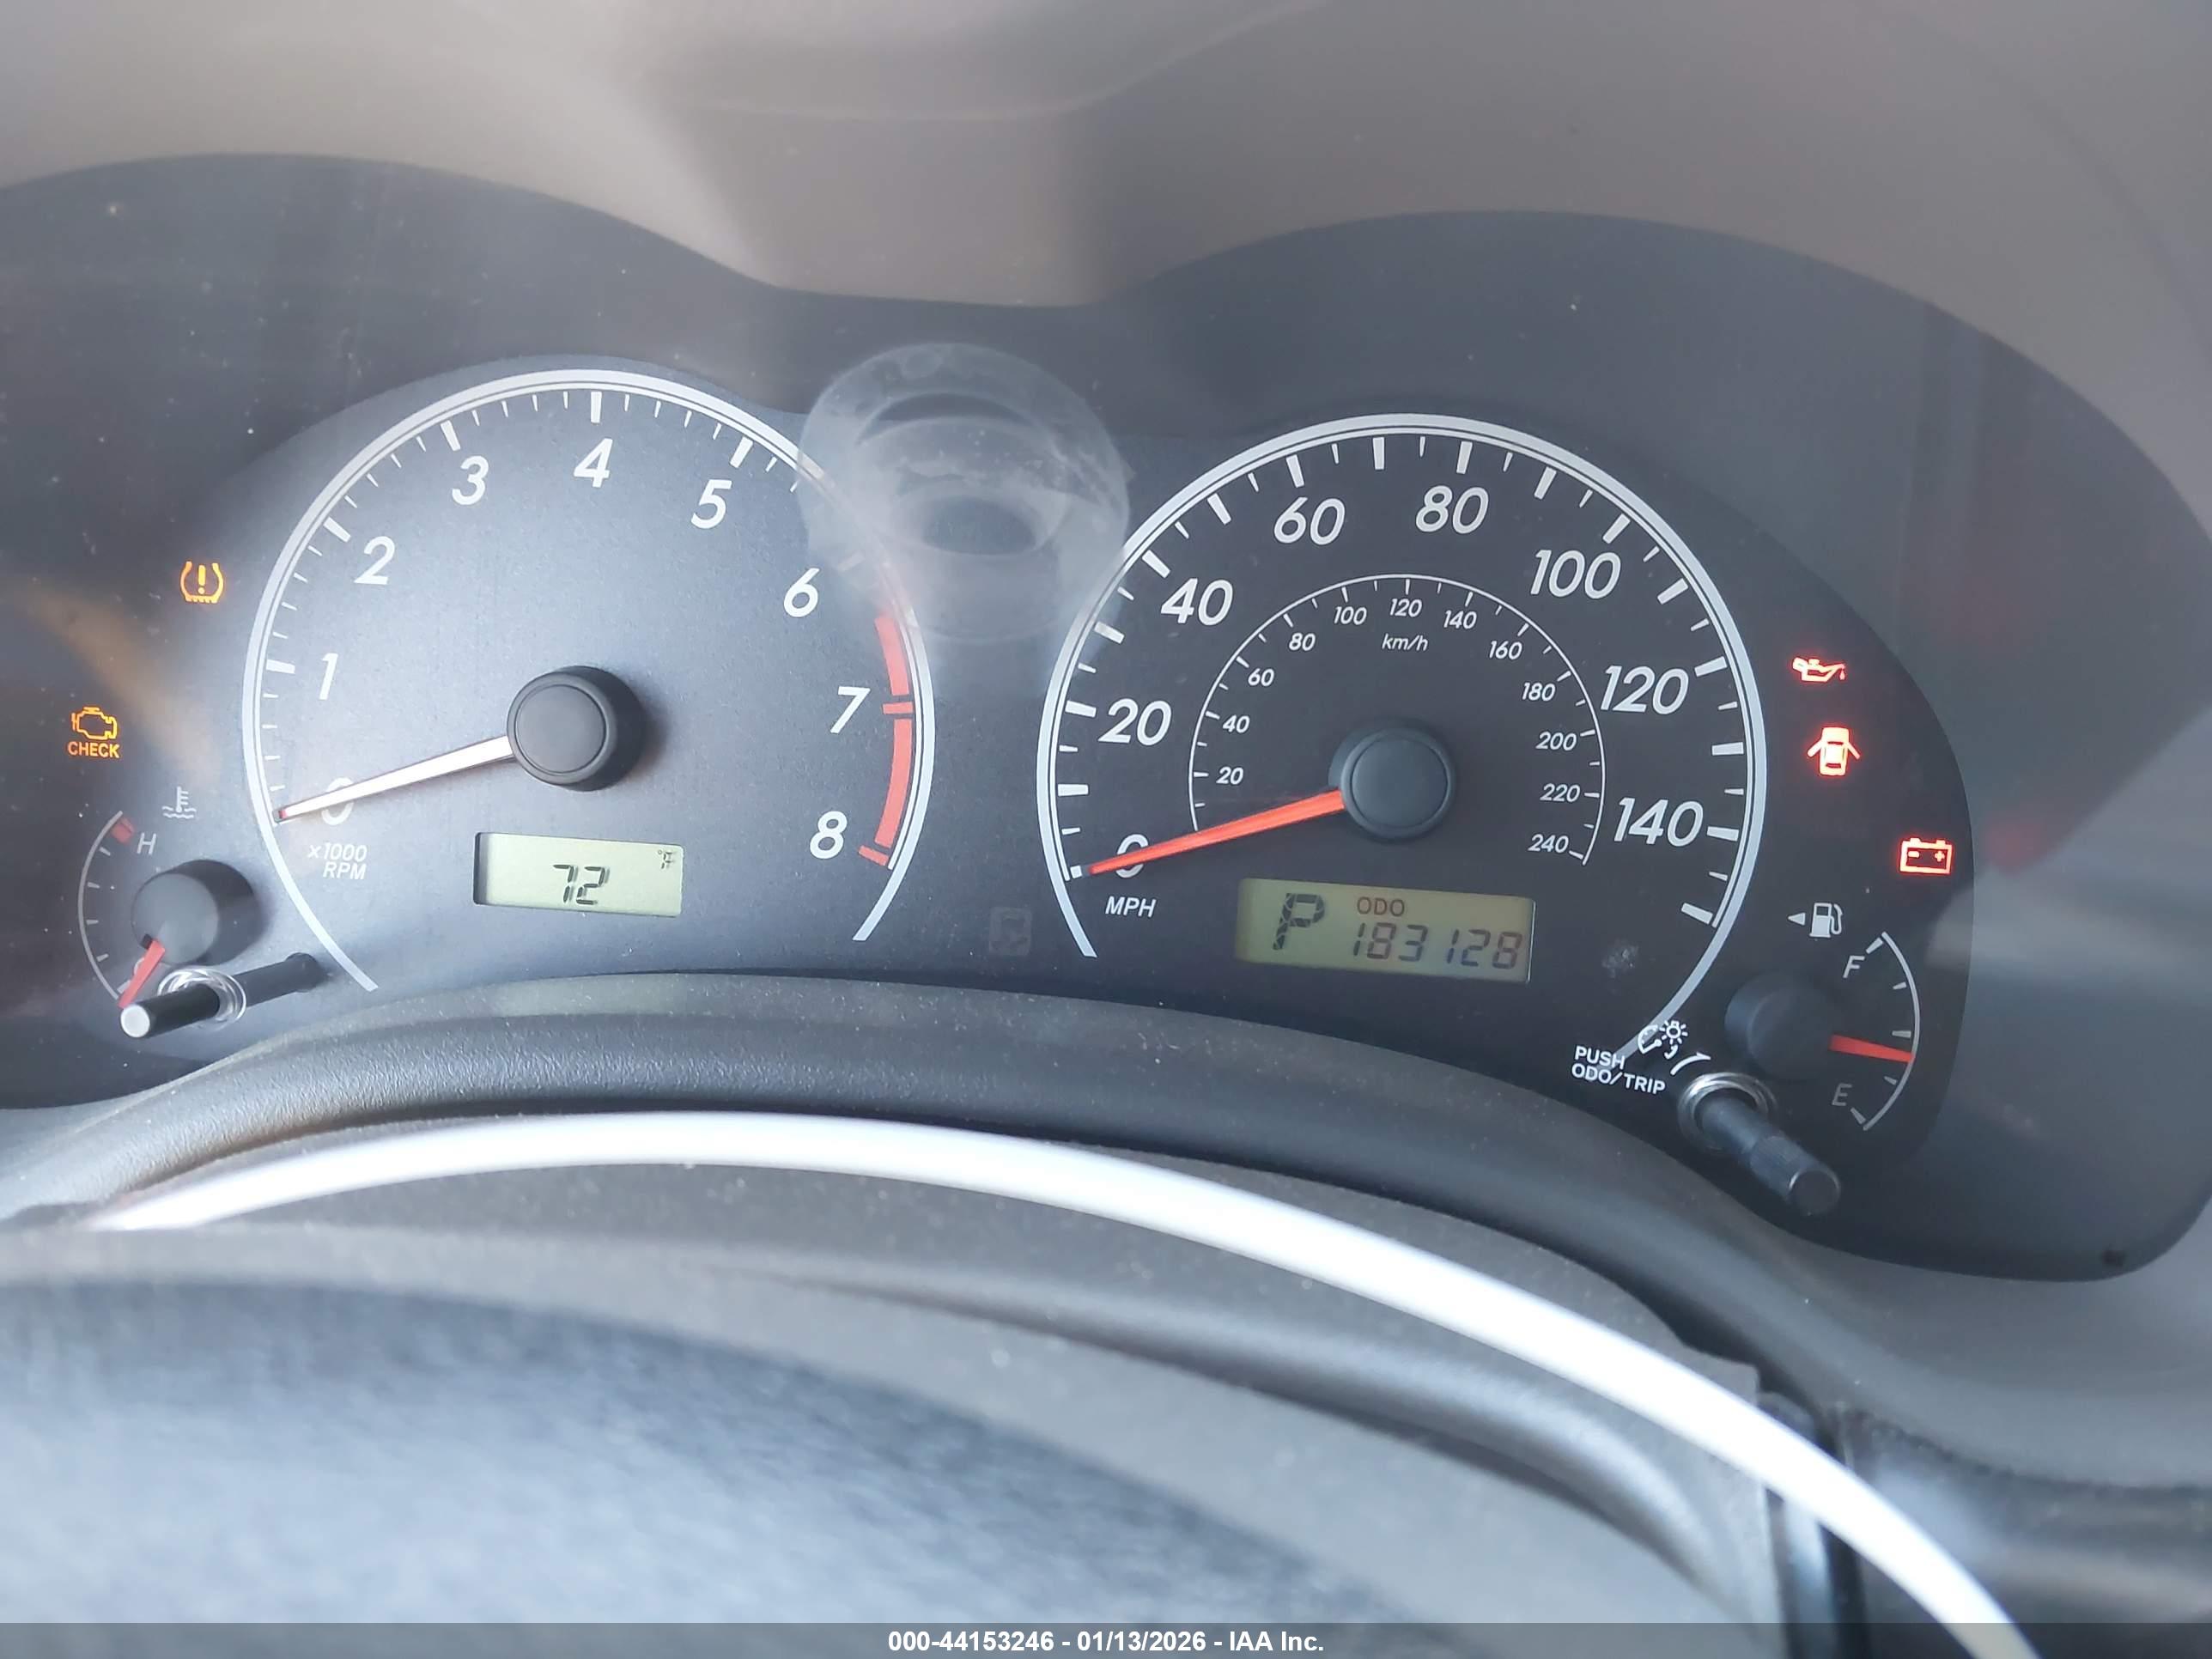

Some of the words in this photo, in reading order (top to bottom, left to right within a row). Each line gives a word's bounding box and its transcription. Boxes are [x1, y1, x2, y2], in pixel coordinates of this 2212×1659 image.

[574, 438, 613, 488] 4
[452, 455, 489, 506] 3
[690, 479, 732, 529] 5
[1415, 485, 1489, 534] 80
[1273, 496, 1346, 545] 60
[354, 536, 396, 585] 2
[1530, 549, 1621, 599] 100
[783, 568, 820, 617] 6
[1160, 578, 1233, 626] 40
[1333, 606, 1367, 626] 100
[1389, 598, 1422, 617] 120
[1443, 609, 1477, 631] 140
[1288, 633, 1316, 652] 80
[1381, 634, 1429, 652] km/h
[1488, 640, 1522, 660] 160
[319, 652, 338, 700] 1
[1248, 668, 1274, 687] 60
[1522, 681, 1556, 702] 180
[1600, 665, 1689, 714] 120
[830, 686, 870, 734] 7
[1097, 698, 1172, 746] 20
[1222, 714, 1250, 734] 40
[68, 741, 120, 758] CHECK
[1535, 731, 1577, 752] 200
[1216, 767, 1243, 786] 20
[1540, 783, 1581, 803] 220
[1613, 797, 1704, 847] 140
[137, 832, 156, 854] H
[810, 811, 848, 859] 8
[1528, 834, 1569, 854] 240
[322, 861, 367, 880] RPM
[552, 864, 607, 905] 72
[1105, 896, 1157, 918] MPH
[1357, 896, 1406, 917] ODO
[1273, 892, 1325, 951] P
[1352, 921, 1522, 970] 183128
[1843, 956, 1865, 979] F
[1574, 1046, 1626, 1070] PUSH
[1571, 1062, 1667, 1095] ODO/TRIP
[1832, 1083, 1852, 1106] E
